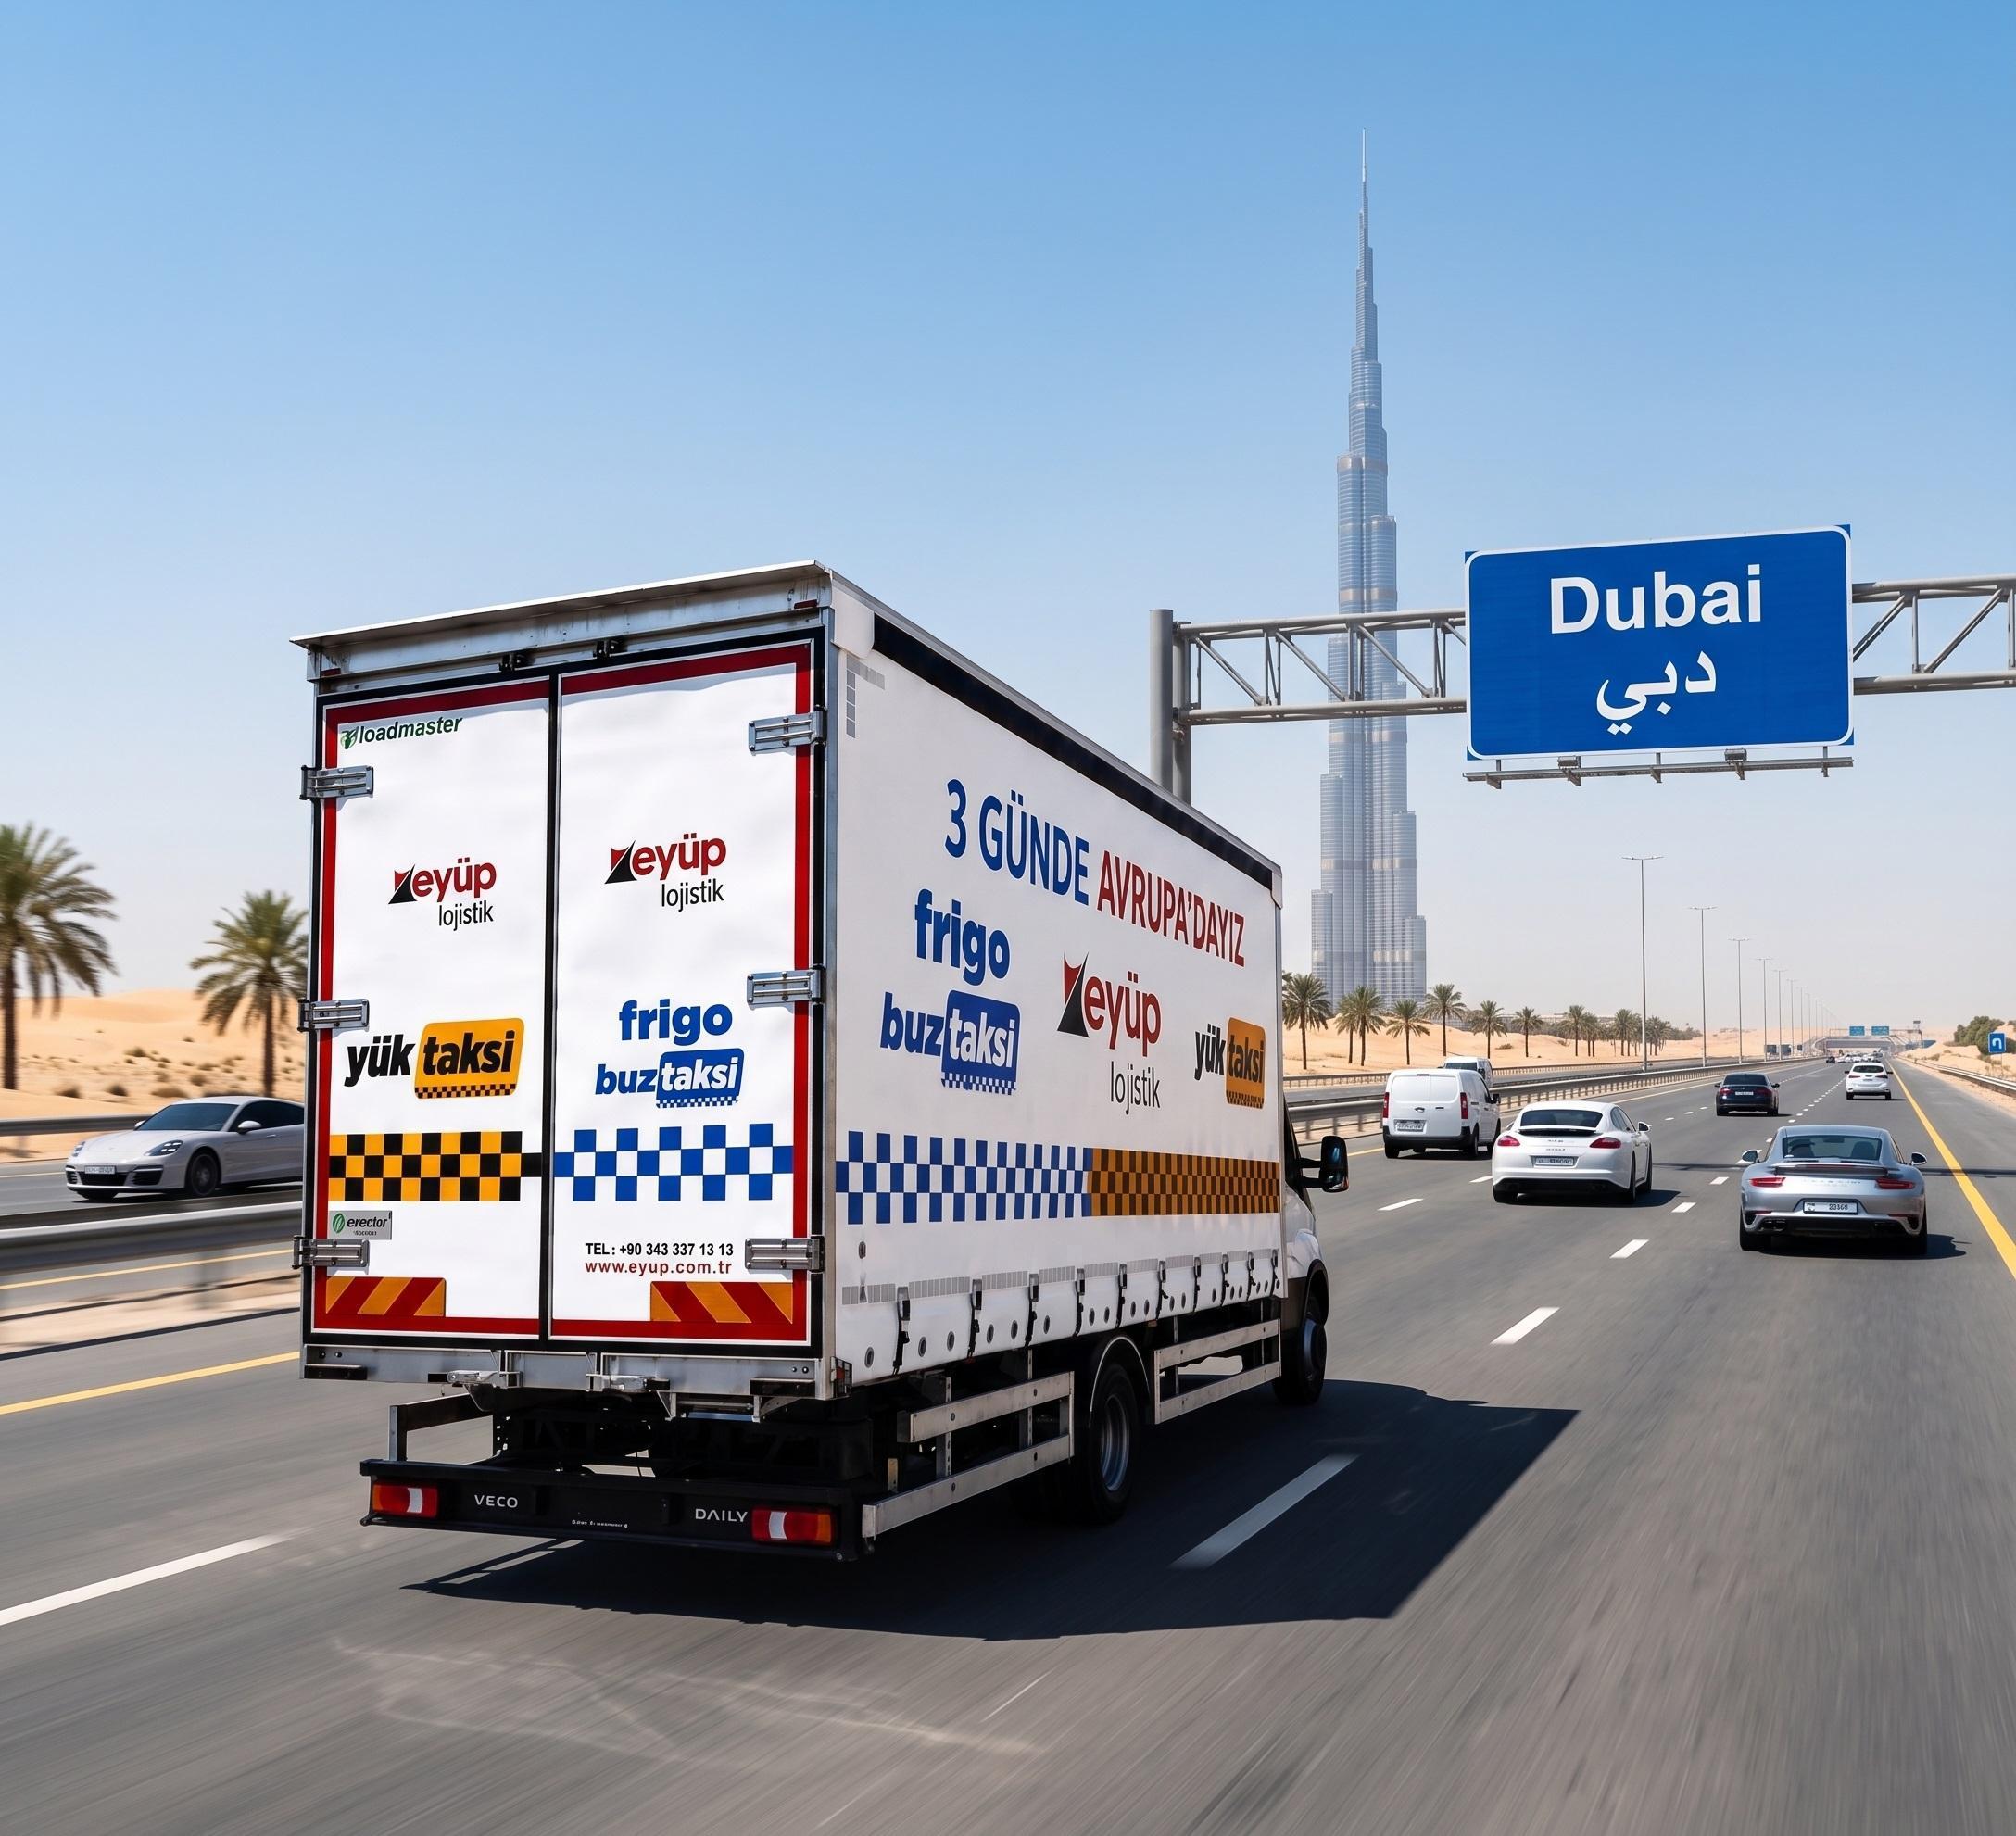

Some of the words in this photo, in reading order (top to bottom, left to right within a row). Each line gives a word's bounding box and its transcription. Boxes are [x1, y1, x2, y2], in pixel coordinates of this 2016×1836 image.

[1550, 563, 1761, 635] Dubai
[1596, 650, 1717, 736] دبي
[359, 717, 463, 744] loadmaster
[411, 857, 497, 903] eyüp
[631, 832, 727, 881] eyüp
[944, 778, 967, 858] 3
[978, 789, 1090, 906] GÜNDE
[1096, 849, 1245, 967] AVRUPA'DAYIZ
[438, 899, 494, 931] lojistik
[661, 878, 724, 912] lojistik
[914, 888, 1010, 986] frigo
[618, 998, 733, 1046] frigo
[1083, 970, 1162, 1057] eyüp
[344, 1034, 416, 1088] yük
[422, 1029, 515, 1075] taksi
[1194, 1023, 1227, 1081] yük
[1228, 1034, 1265, 1084] taksi
[1110, 1061, 1162, 1115] lojistik
[346, 1216, 387, 1228] erector
[585, 1260, 733, 1276] www.eyup.com.tr
[619, 1243, 642, 1255] +90
[646, 1243, 668, 1255] 343
[672, 1243, 695, 1255] 337
[699, 1243, 714, 1256] 13
[718, 1243, 734, 1256] 13
[473, 1494, 519, 1508] VECO
[695, 1508, 749, 1523] DAILY
